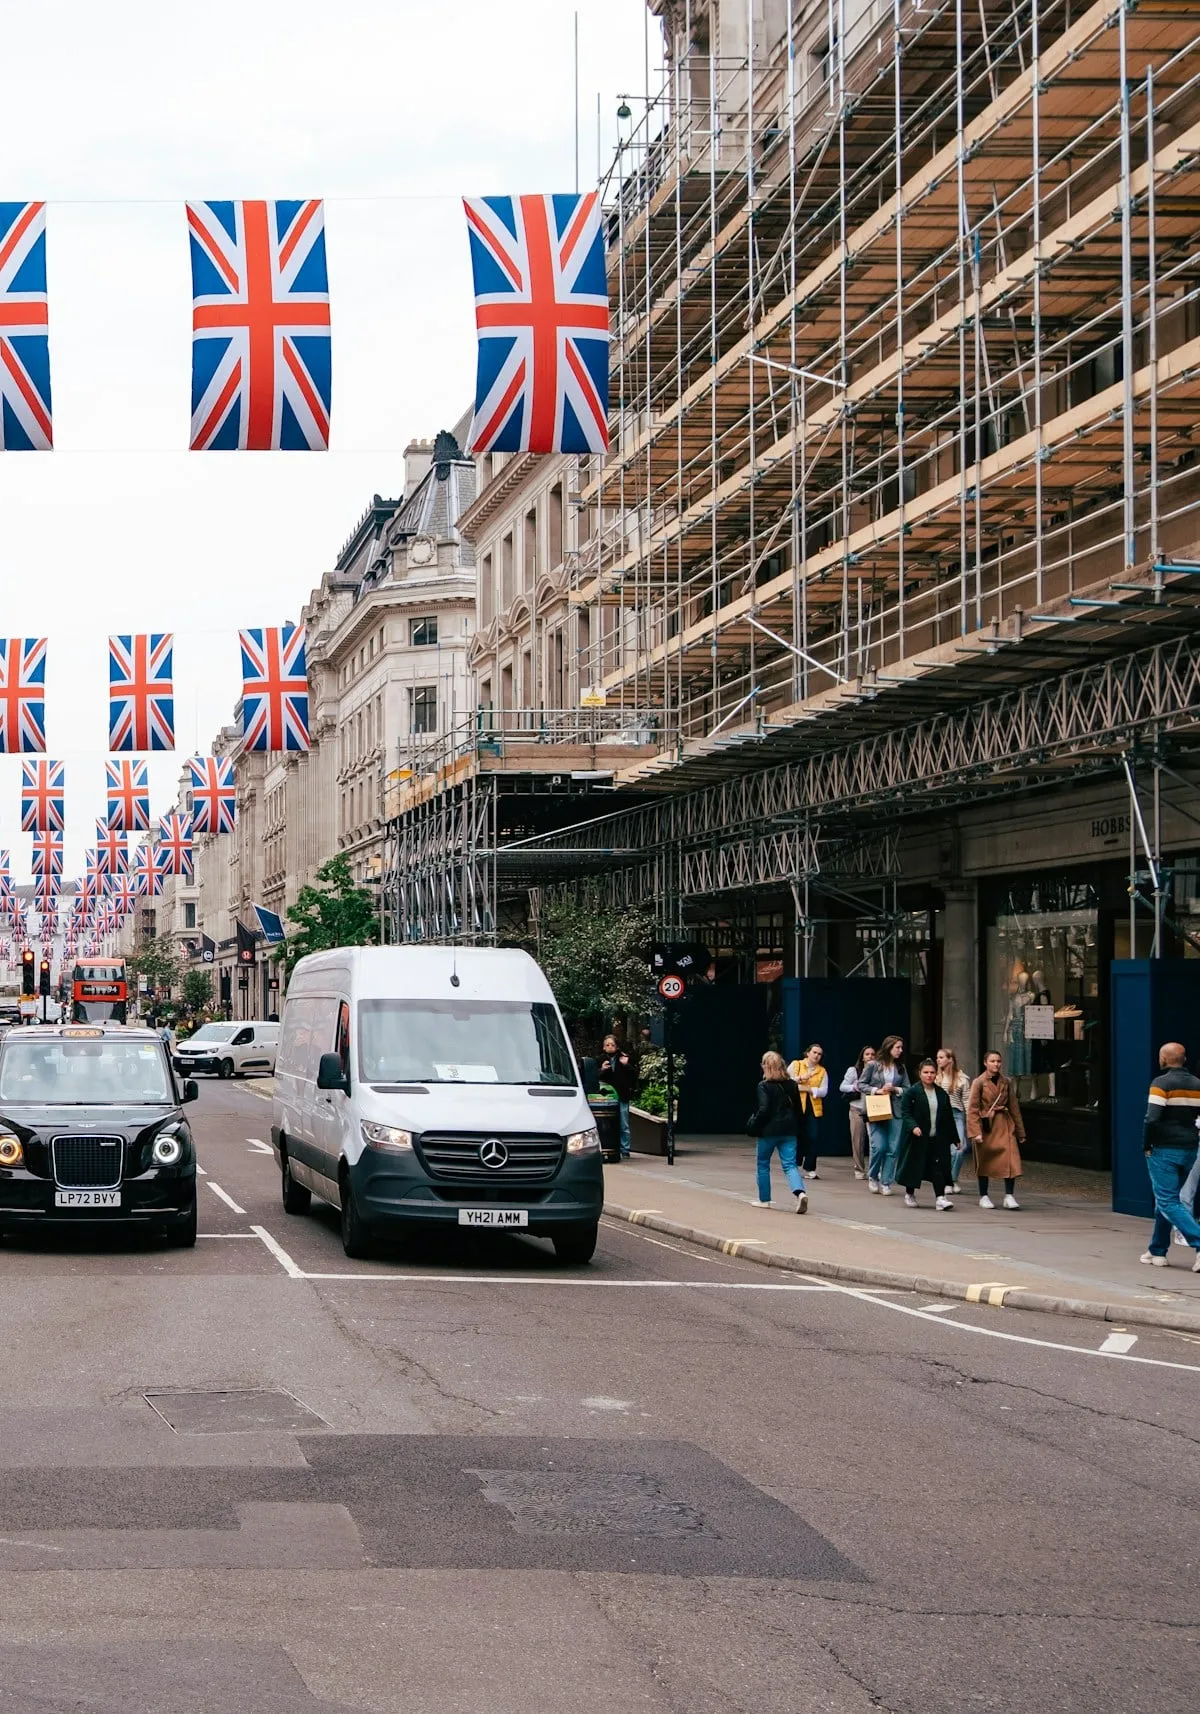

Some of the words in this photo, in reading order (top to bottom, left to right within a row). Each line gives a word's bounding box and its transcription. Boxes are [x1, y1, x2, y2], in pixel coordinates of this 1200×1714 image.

[1091, 815, 1131, 837] HOBBS
[107, 985, 118, 994] 94
[664, 982, 680, 992] 20
[60, 1193, 90, 1204] LP72
[93, 1193, 116, 1204] BVY
[467, 1211, 494, 1224] YH21
[497, 1212, 521, 1224] AMM
